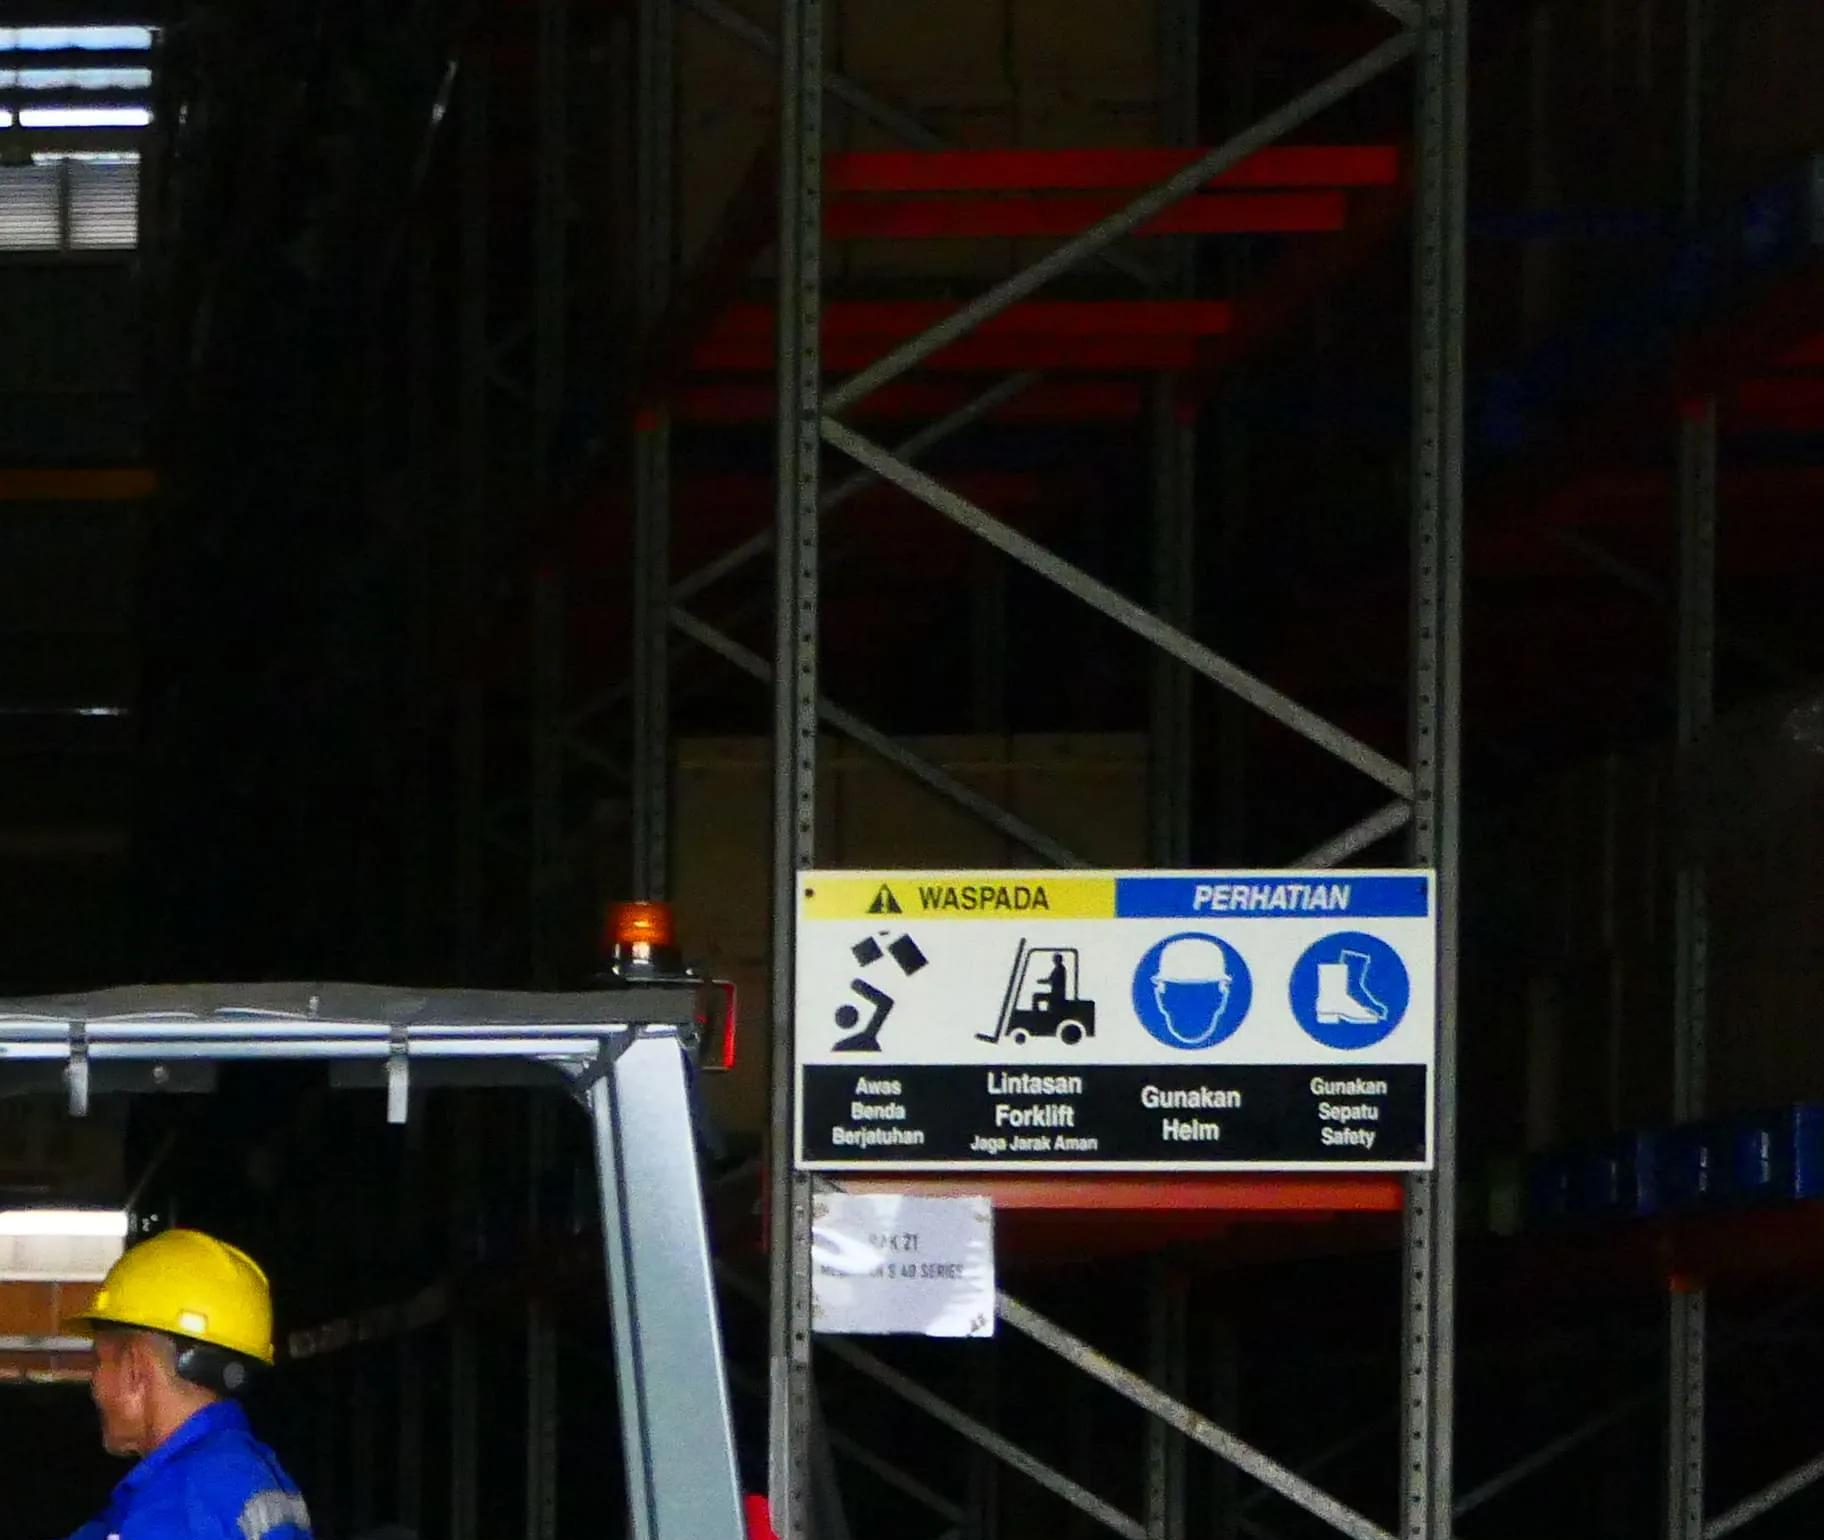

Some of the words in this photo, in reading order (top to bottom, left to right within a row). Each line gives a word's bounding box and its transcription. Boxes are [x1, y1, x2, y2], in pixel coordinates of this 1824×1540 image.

[919, 884, 1049, 911] WASPADA
[1192, 884, 1351, 911] PERHATIAN
[855, 1077, 902, 1096] Awas
[987, 1071, 1083, 1095] Lintasan
[1309, 1076, 1388, 1096] Gunakan
[1140, 1085, 1242, 1109] Gunakan
[851, 1101, 906, 1120] Benda
[995, 1103, 1074, 1127] Forklift
[1318, 1101, 1379, 1124] Sepatu
[832, 1126, 925, 1149] Berjatuhan
[1161, 1118, 1220, 1141] Helm
[1321, 1126, 1376, 1150] Safety
[970, 1135, 1007, 1154] Jaga
[1009, 1135, 1051, 1152] Jarak
[1054, 1135, 1098, 1152] Aman
